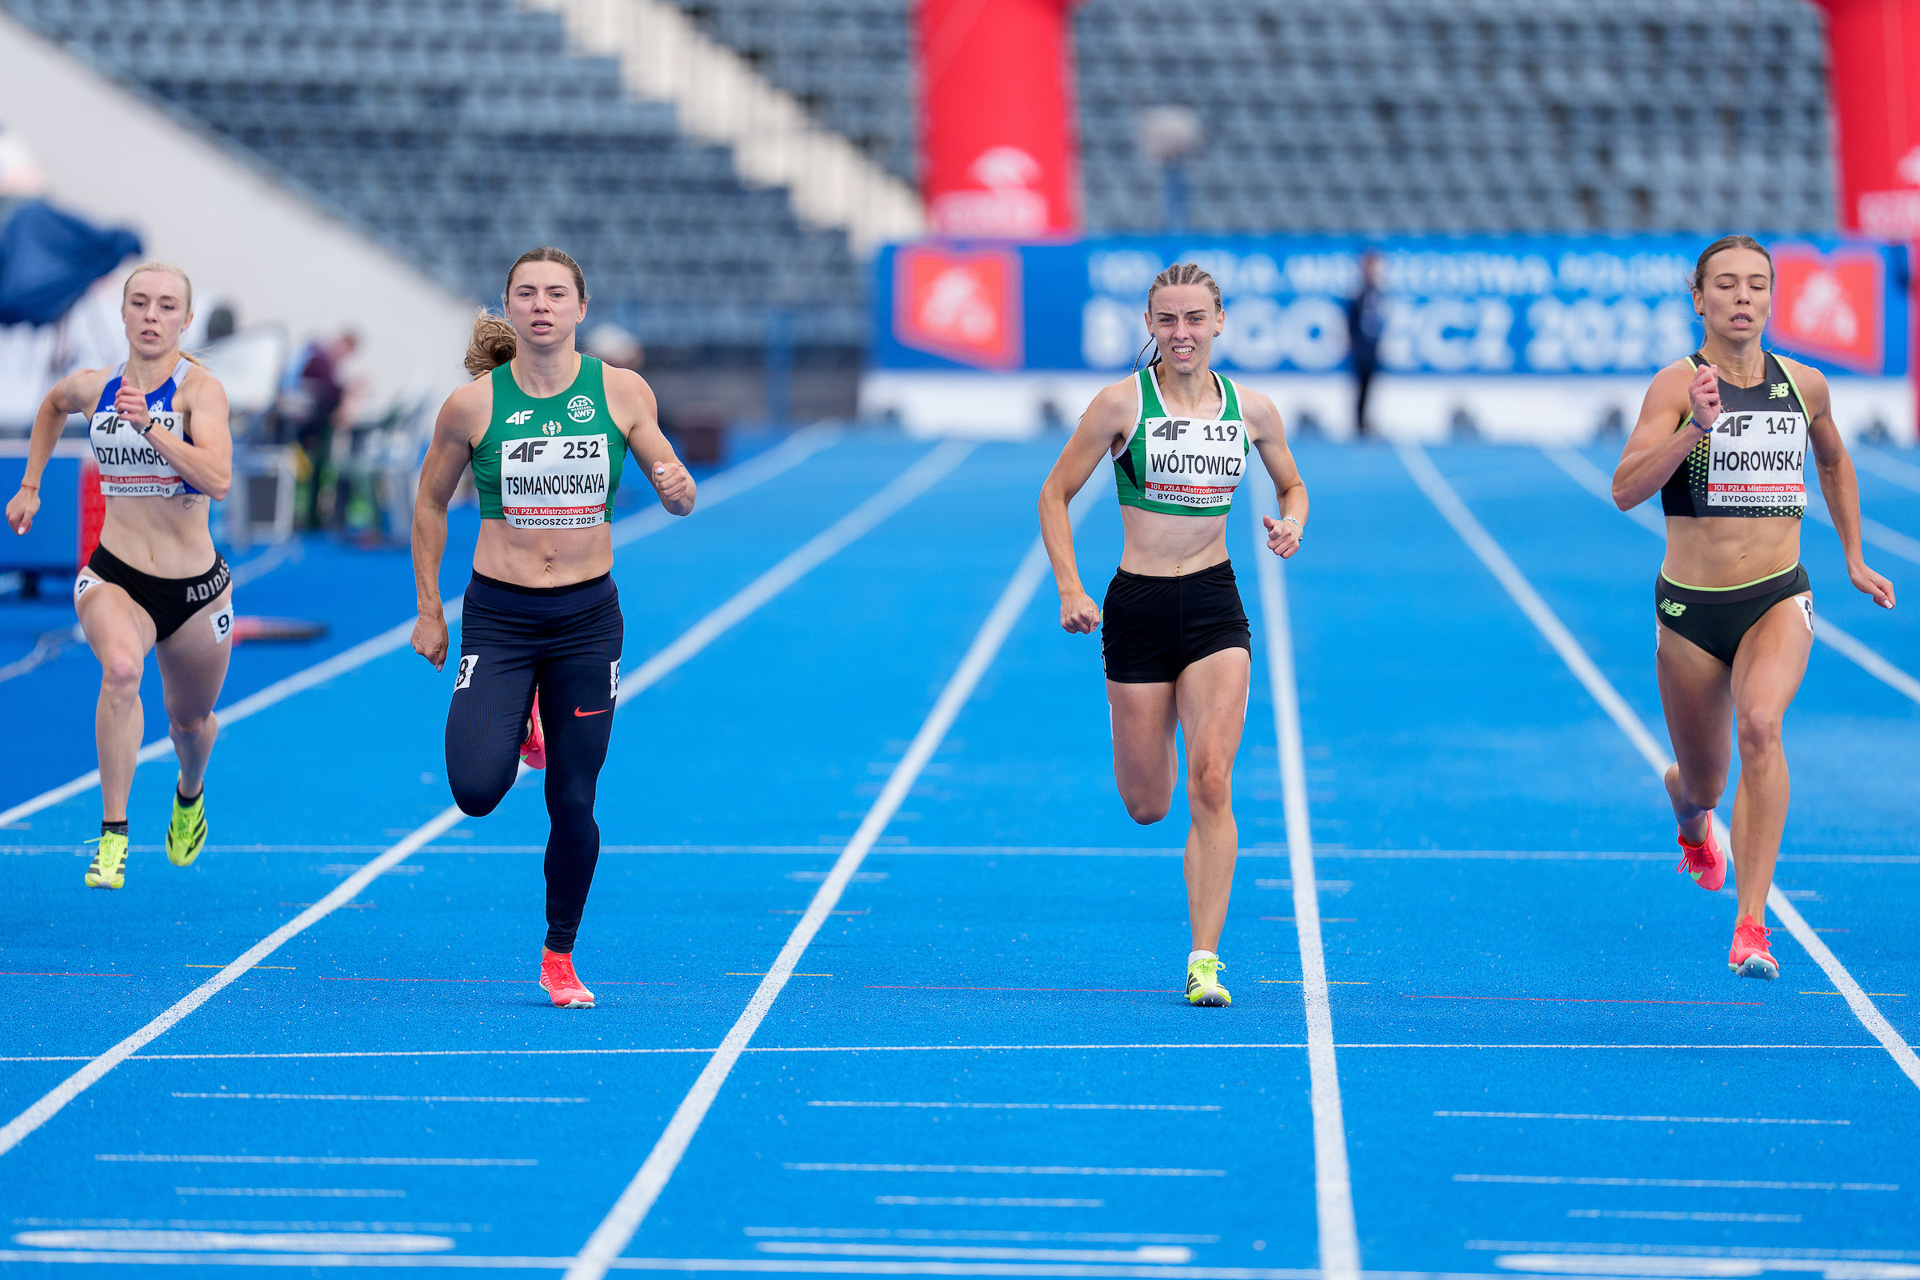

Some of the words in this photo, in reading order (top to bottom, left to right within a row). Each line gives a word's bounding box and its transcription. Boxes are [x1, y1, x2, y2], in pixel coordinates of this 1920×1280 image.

[572, 399, 588, 408] AZS
[505, 410, 534, 425] 4F
[574, 409, 592, 419] AWF
[1152, 420, 1190, 440] 4F
[1203, 425, 1238, 441] 119
[1717, 415, 1753, 436] 4F
[1766, 417, 1796, 434] 147
[96, 447, 168, 467] DZIAMSK
[508, 441, 548, 462] 4F
[563, 441, 600, 459] 252
[1713, 451, 1802, 471] HOROWSKA
[1151, 450, 1242, 477] WÓJTOWICZ
[109, 485, 155, 493] BYDGOSZCZ
[506, 473, 605, 496] TSIMANOUSKAYA
[1210, 496, 1223, 504] 2025
[515, 518, 574, 526] BYDGOSZCZ
[575, 517, 596, 525] 2025
[186, 559, 230, 603] ADIDAS
[217, 614, 230, 635] 9
[456, 658, 470, 688] 8
